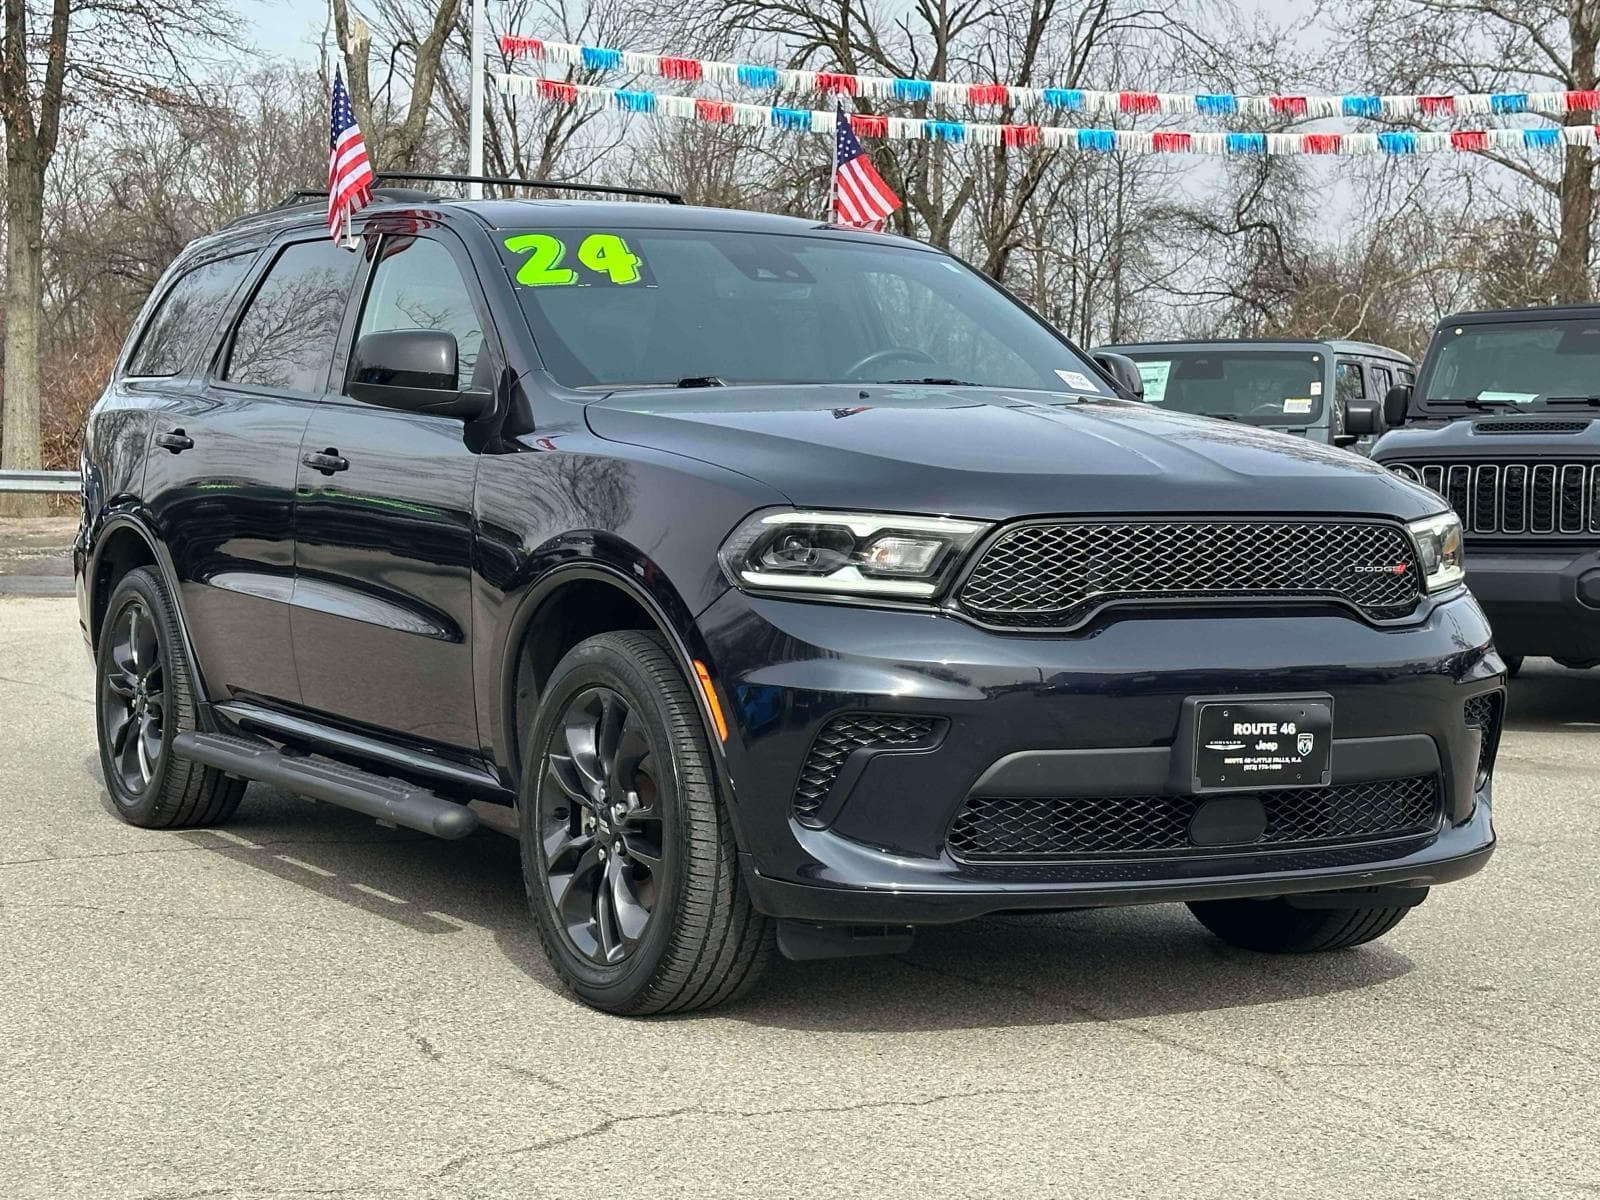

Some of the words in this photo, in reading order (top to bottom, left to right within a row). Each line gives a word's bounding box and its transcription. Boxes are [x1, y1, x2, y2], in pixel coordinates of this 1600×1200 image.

[504, 233, 642, 286] 24
[1233, 722, 1277, 735] ROUTE
[1280, 722, 1296, 735] 46
[1255, 740, 1278, 752] Jeep
